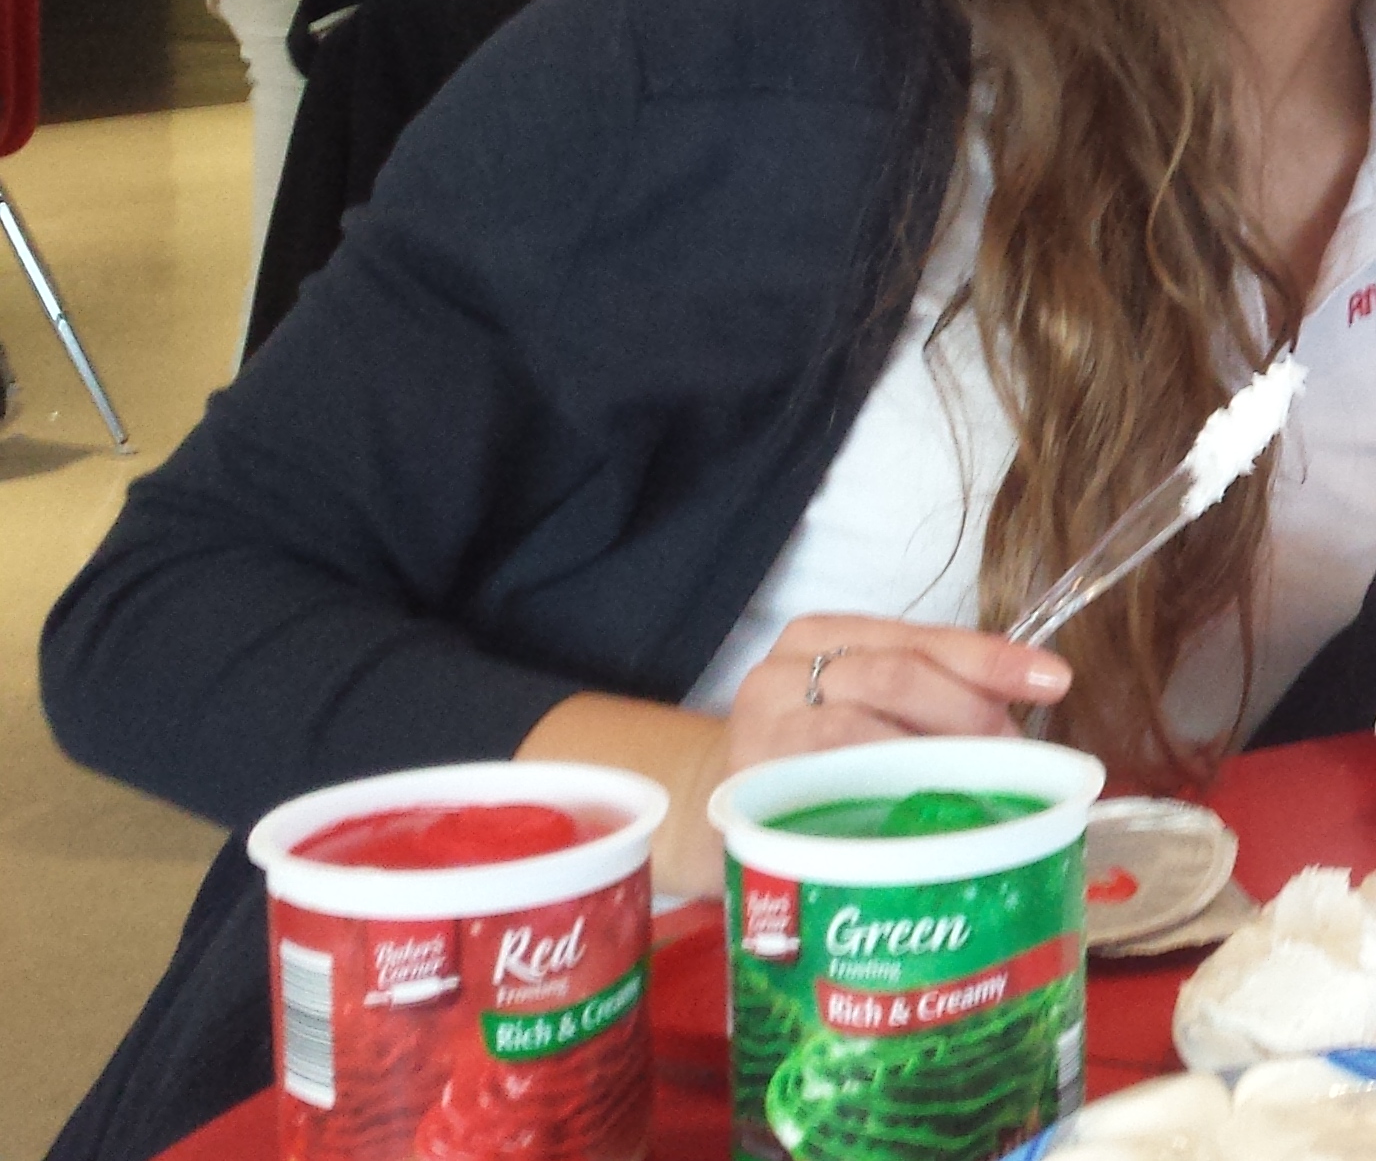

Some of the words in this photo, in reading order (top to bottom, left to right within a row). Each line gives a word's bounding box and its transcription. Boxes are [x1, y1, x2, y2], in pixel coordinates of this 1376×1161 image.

[492, 915, 587, 986] Red
[825, 905, 972, 958] Green
[829, 992, 883, 1028] Rich
[888, 997, 912, 1027] &
[916, 971, 1009, 1023] Creamy
[496, 1018, 552, 1052] Rich
[558, 1010, 578, 1042] &
